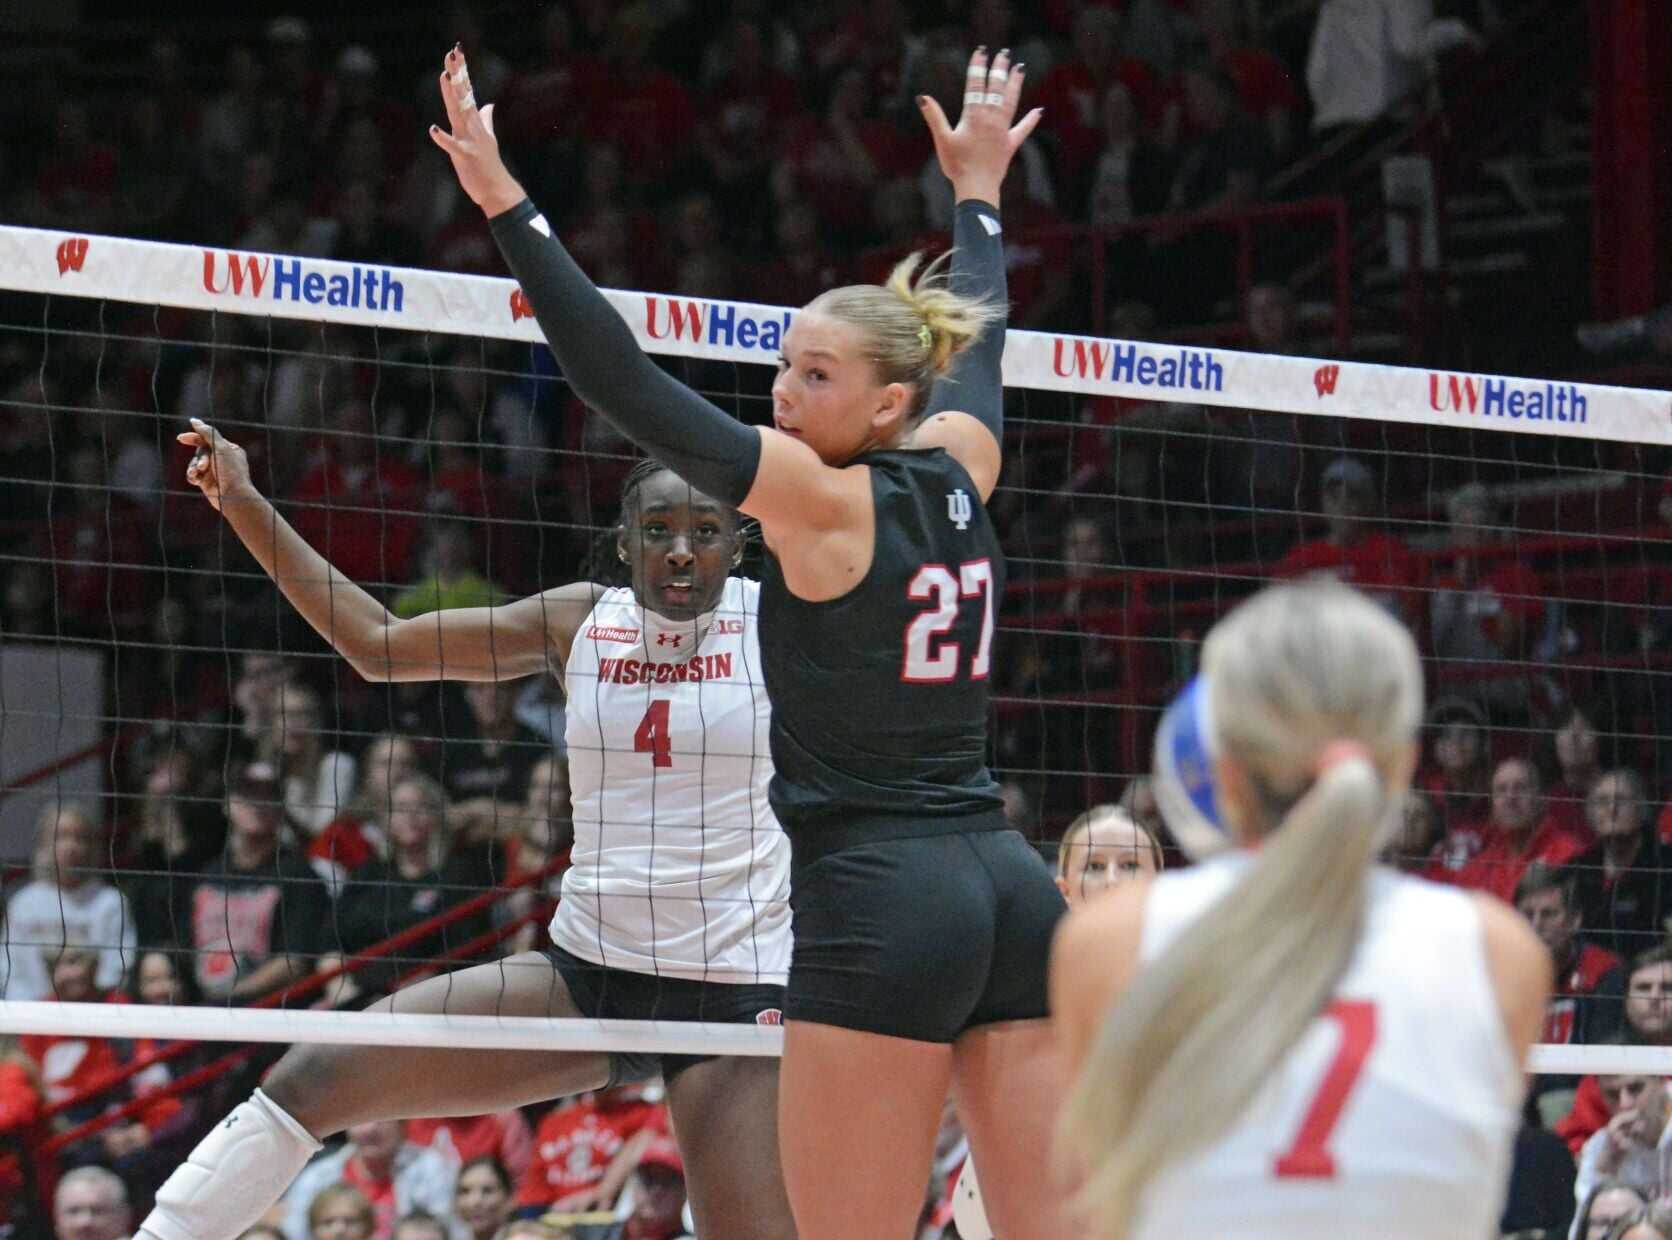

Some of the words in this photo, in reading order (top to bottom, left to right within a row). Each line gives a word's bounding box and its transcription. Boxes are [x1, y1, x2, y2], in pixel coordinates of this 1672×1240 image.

[899, 557, 995, 684] 27
[598, 652, 732, 685] WISCONSIN
[633, 699, 673, 768] 4
